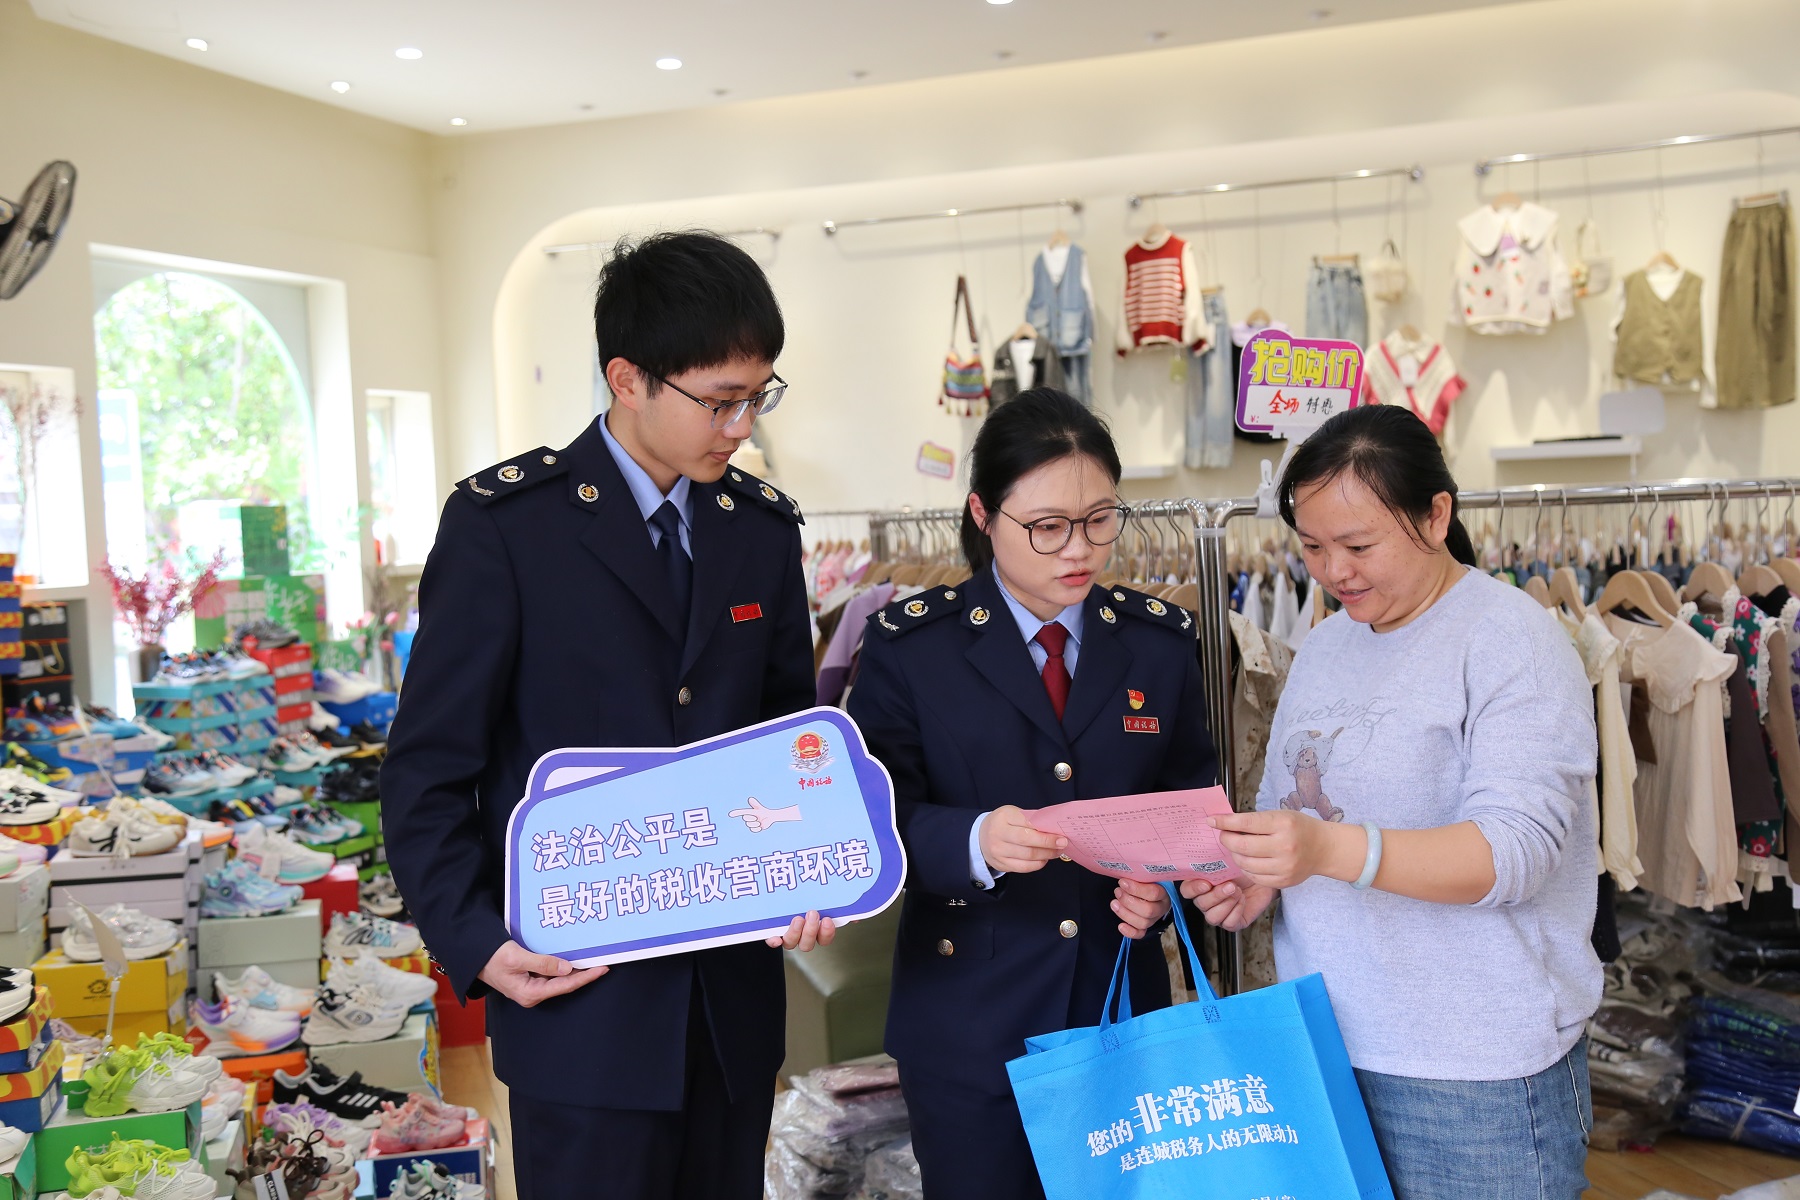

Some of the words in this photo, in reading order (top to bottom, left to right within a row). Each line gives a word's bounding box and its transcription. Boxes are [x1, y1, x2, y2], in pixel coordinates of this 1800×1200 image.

[1248, 338, 1360, 388] 抢购价
[1269, 389, 1300, 416] 全场
[531, 807, 718, 872] 法治公平是
[538, 839, 873, 928] 最好的税收营商环境
[1086, 1073, 1275, 1157] 您的非常满意
[1119, 1123, 1299, 1174] 是连城税务人的无限动力
